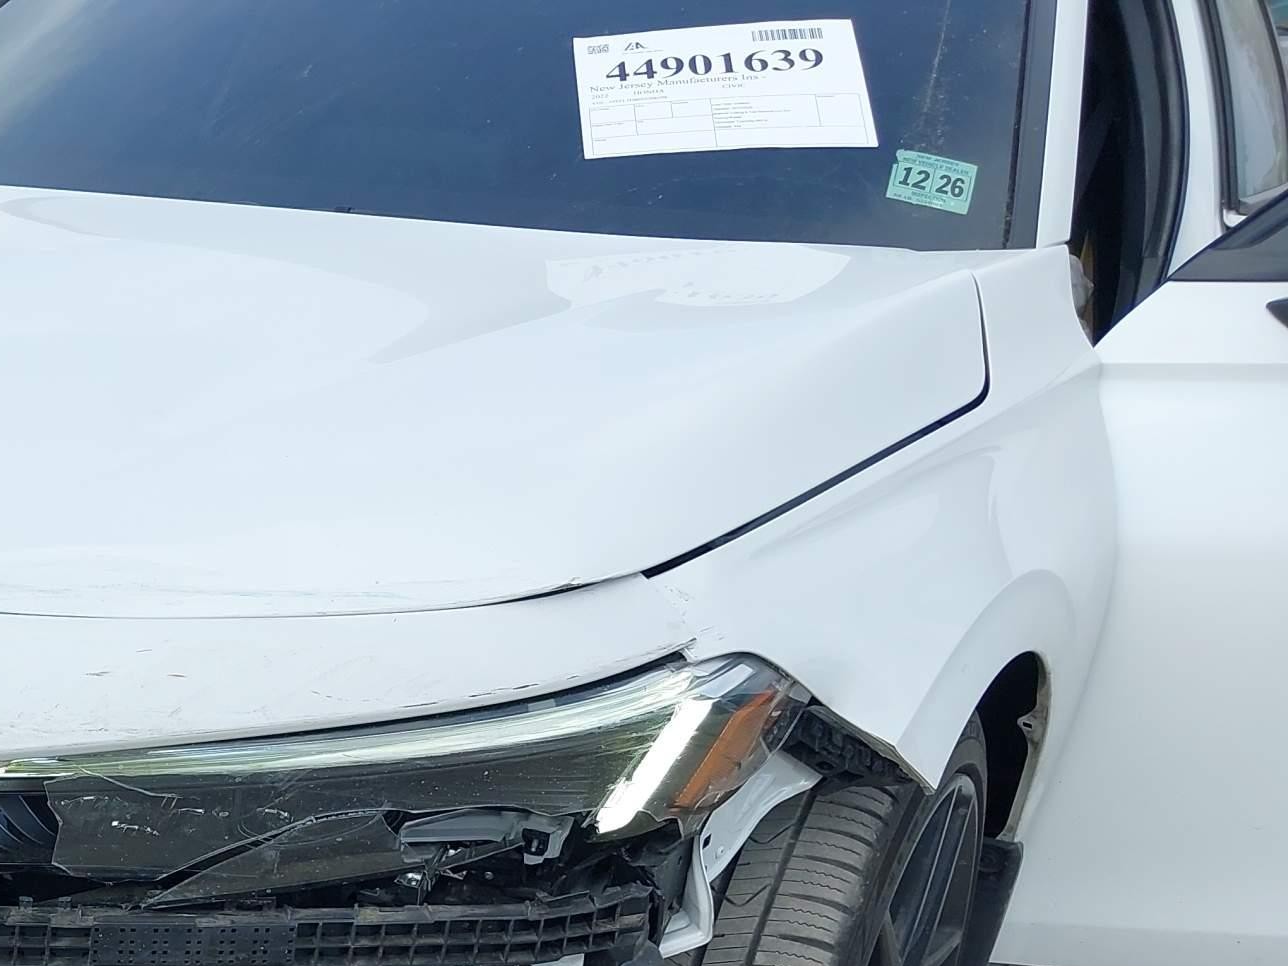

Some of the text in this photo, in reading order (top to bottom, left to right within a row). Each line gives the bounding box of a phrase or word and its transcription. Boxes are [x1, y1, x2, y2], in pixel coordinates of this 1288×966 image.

[605, 47, 824, 82] 44901639
[589, 85, 615, 93] New
[618, 81, 653, 90] Jersey
[656, 74, 739, 87] Manufacturers
[898, 166, 931, 191] 12
[934, 174, 966, 198] 26
